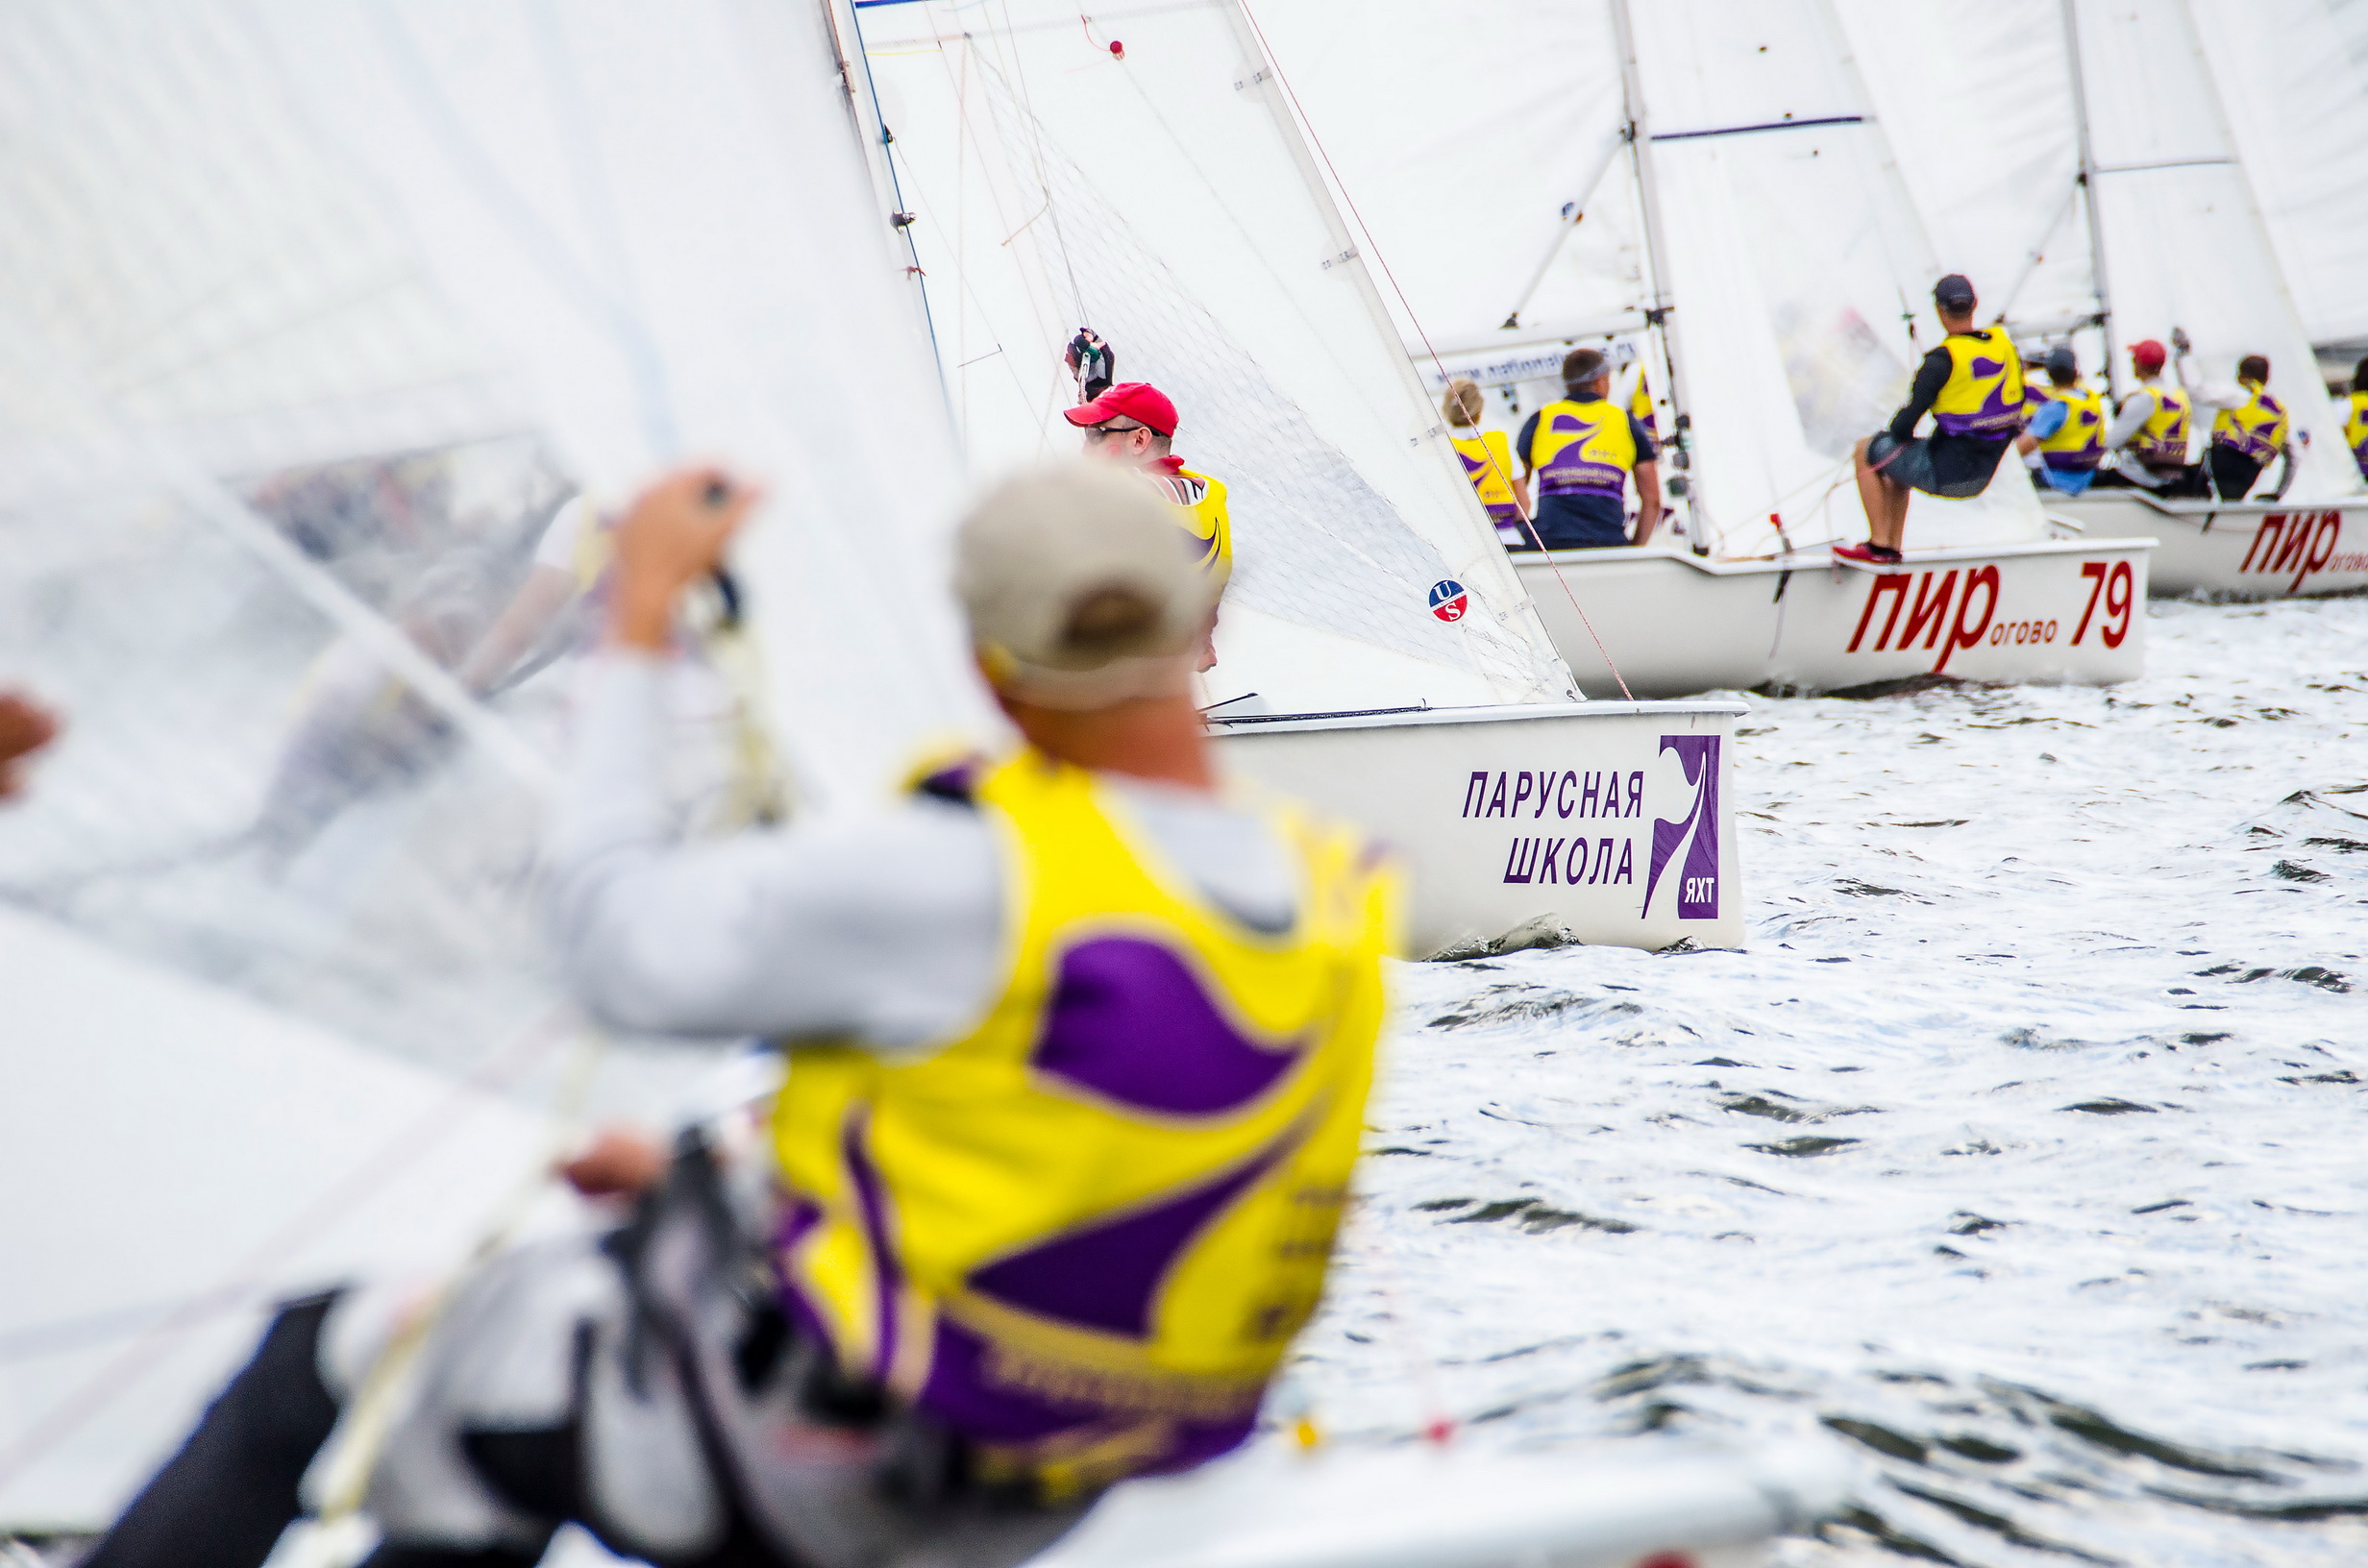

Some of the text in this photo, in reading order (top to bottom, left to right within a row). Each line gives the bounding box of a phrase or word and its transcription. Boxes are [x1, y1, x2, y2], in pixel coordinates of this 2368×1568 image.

[2069, 560, 2134, 649] 79
[1462, 770, 1644, 819] ПАРУСНАЯ
[1502, 837, 1633, 885] ШКОЛА
[1684, 877, 1715, 903] ЯХТ
